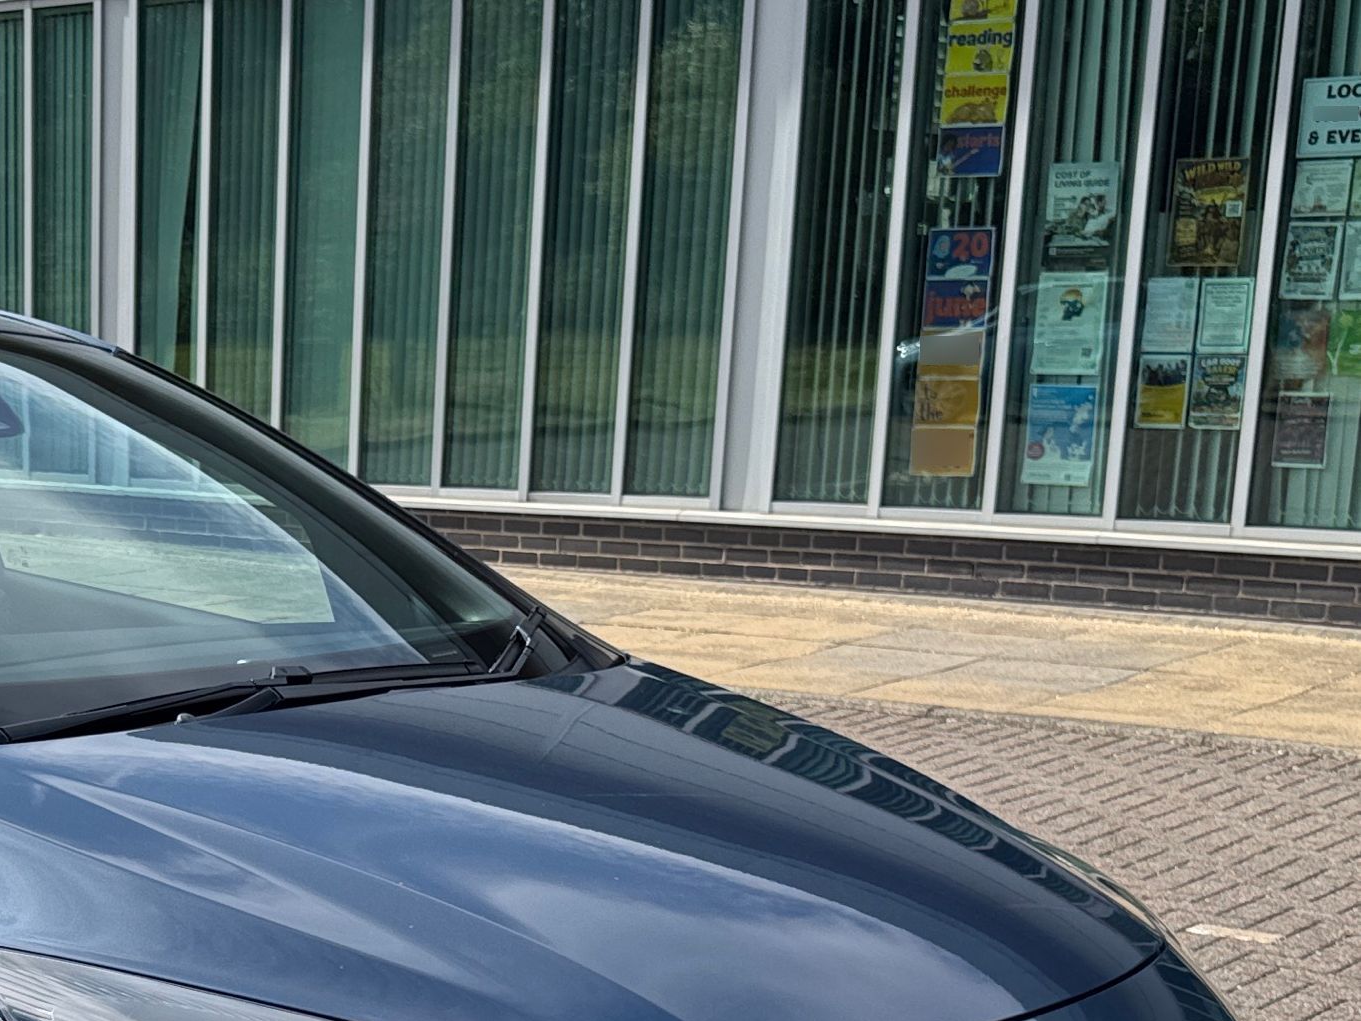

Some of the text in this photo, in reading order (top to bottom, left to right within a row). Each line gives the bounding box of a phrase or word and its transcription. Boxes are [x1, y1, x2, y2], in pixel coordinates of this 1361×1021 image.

[948, 28, 1013, 48] reading
[944, 85, 1007, 99] challenge
[1327, 84, 1361, 99] LOC
[1308, 129, 1361, 145] & EVE
[952, 231, 989, 258] 20
